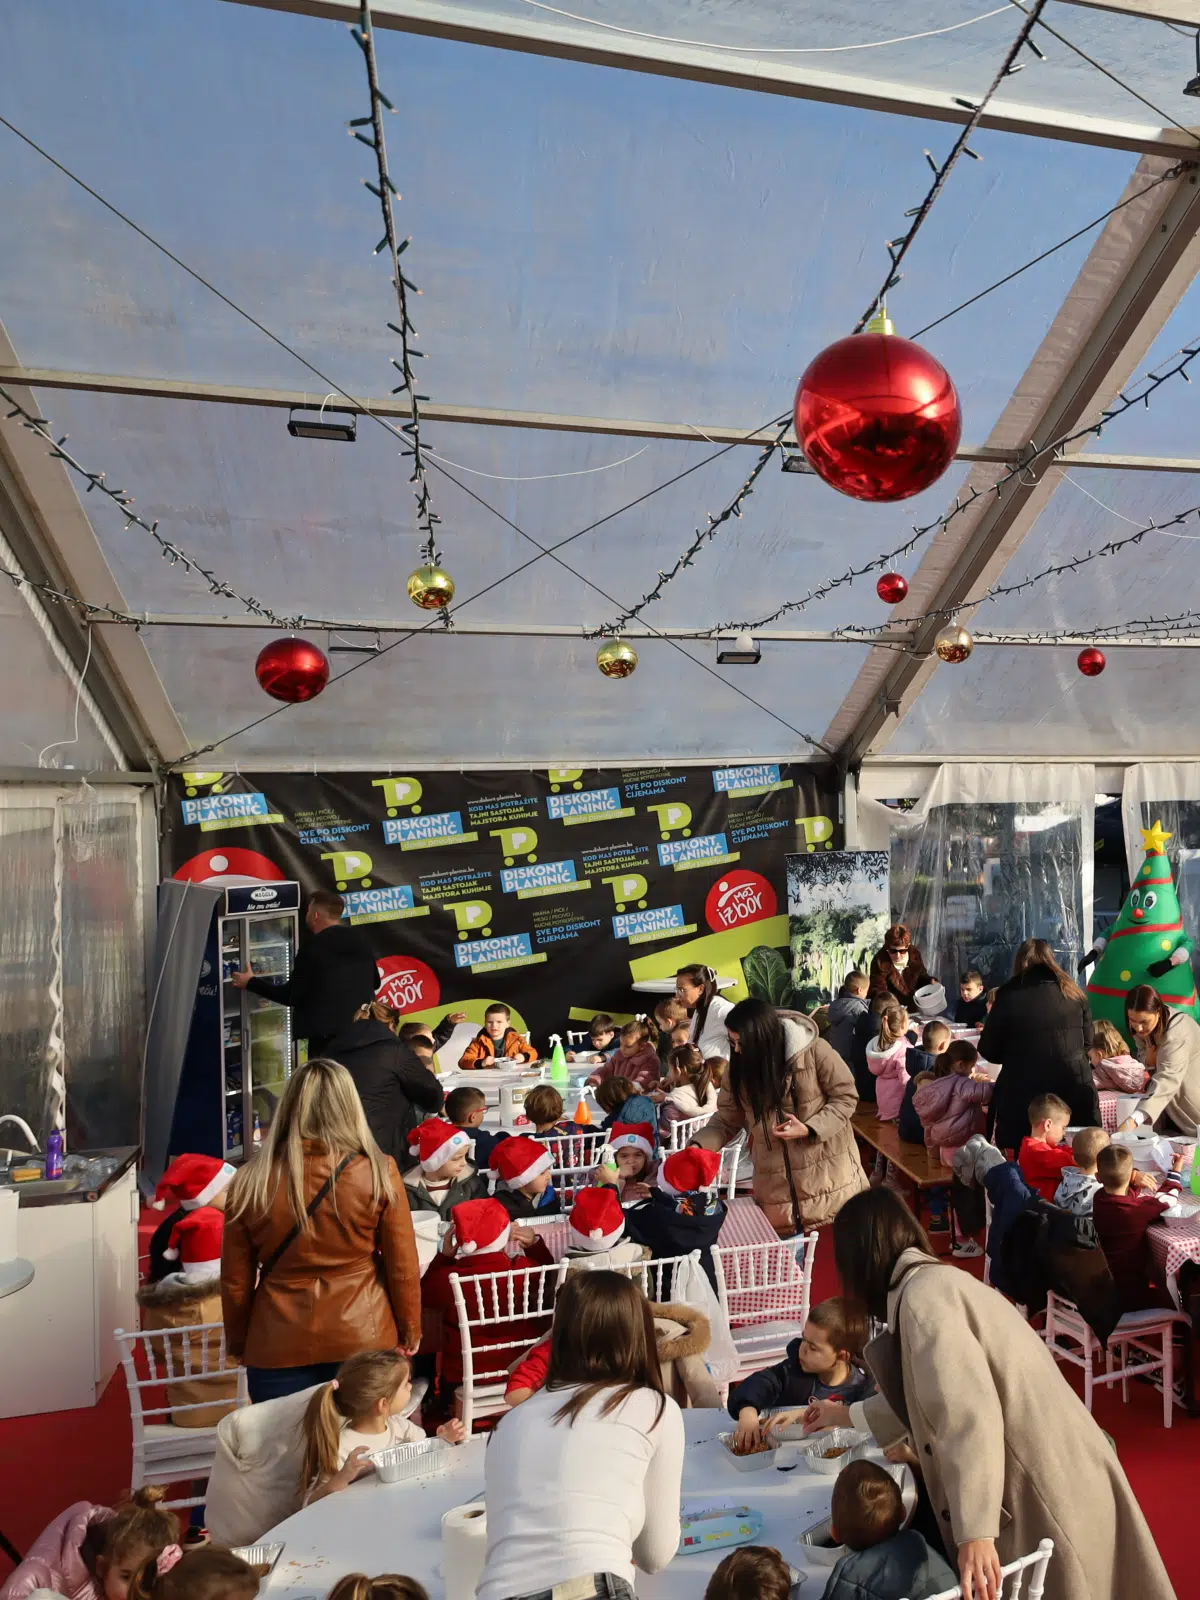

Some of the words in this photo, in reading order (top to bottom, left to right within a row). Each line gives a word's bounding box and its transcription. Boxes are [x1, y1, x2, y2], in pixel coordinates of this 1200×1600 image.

[716, 765, 770, 780] DISKONT
[625, 784, 640, 792] SVE
[653, 776, 687, 787] DISKONT
[717, 772, 776, 790] PLANINIĆ
[550, 790, 609, 807] DISKONT
[626, 787, 666, 798] CIJENAMA
[186, 794, 254, 812] DISKONT
[500, 797, 538, 807] POTRAŽITE
[551, 796, 616, 817] PLANINIĆ
[187, 801, 262, 823] PLANINIĆ
[469, 811, 489, 819] TAJNI
[490, 806, 524, 816] SASTOJAK
[471, 817, 508, 826] MAJSTORA
[509, 811, 539, 820] KUHINJE
[331, 823, 370, 834] DISKONT
[386, 814, 450, 832] DISKONT
[757, 820, 790, 831] DISKONT
[300, 835, 346, 845] CIJENAMA
[388, 821, 457, 844] PLANINIĆ
[732, 831, 769, 843] CIJENAMA
[613, 846, 649, 857] POTRAŽITE
[661, 836, 716, 854] DISKONT
[662, 842, 723, 864] PLANINIĆ
[584, 866, 620, 875] MAJSTORA
[621, 859, 650, 869] KUHINJE
[603, 855, 636, 865] SASTOJAK
[453, 871, 492, 882] POTRAŽITE
[503, 862, 564, 881] DISKONT
[421, 886, 441, 894] TAJNI
[443, 880, 478, 890] SASTOJAK
[505, 869, 571, 891] PLANINIĆ
[422, 891, 460, 900] MAJSTORA
[461, 885, 492, 894] KUHINJE
[615, 907, 673, 927] DISKONT
[716, 892, 762, 926] izbor
[536, 928, 551, 937] SVE
[566, 919, 601, 931] DISKONT
[617, 914, 680, 936] PLANINIĆ
[457, 936, 519, 955] DISKONT
[537, 931, 579, 944] CIJENAMA
[459, 943, 527, 966] PLANINIĆ
